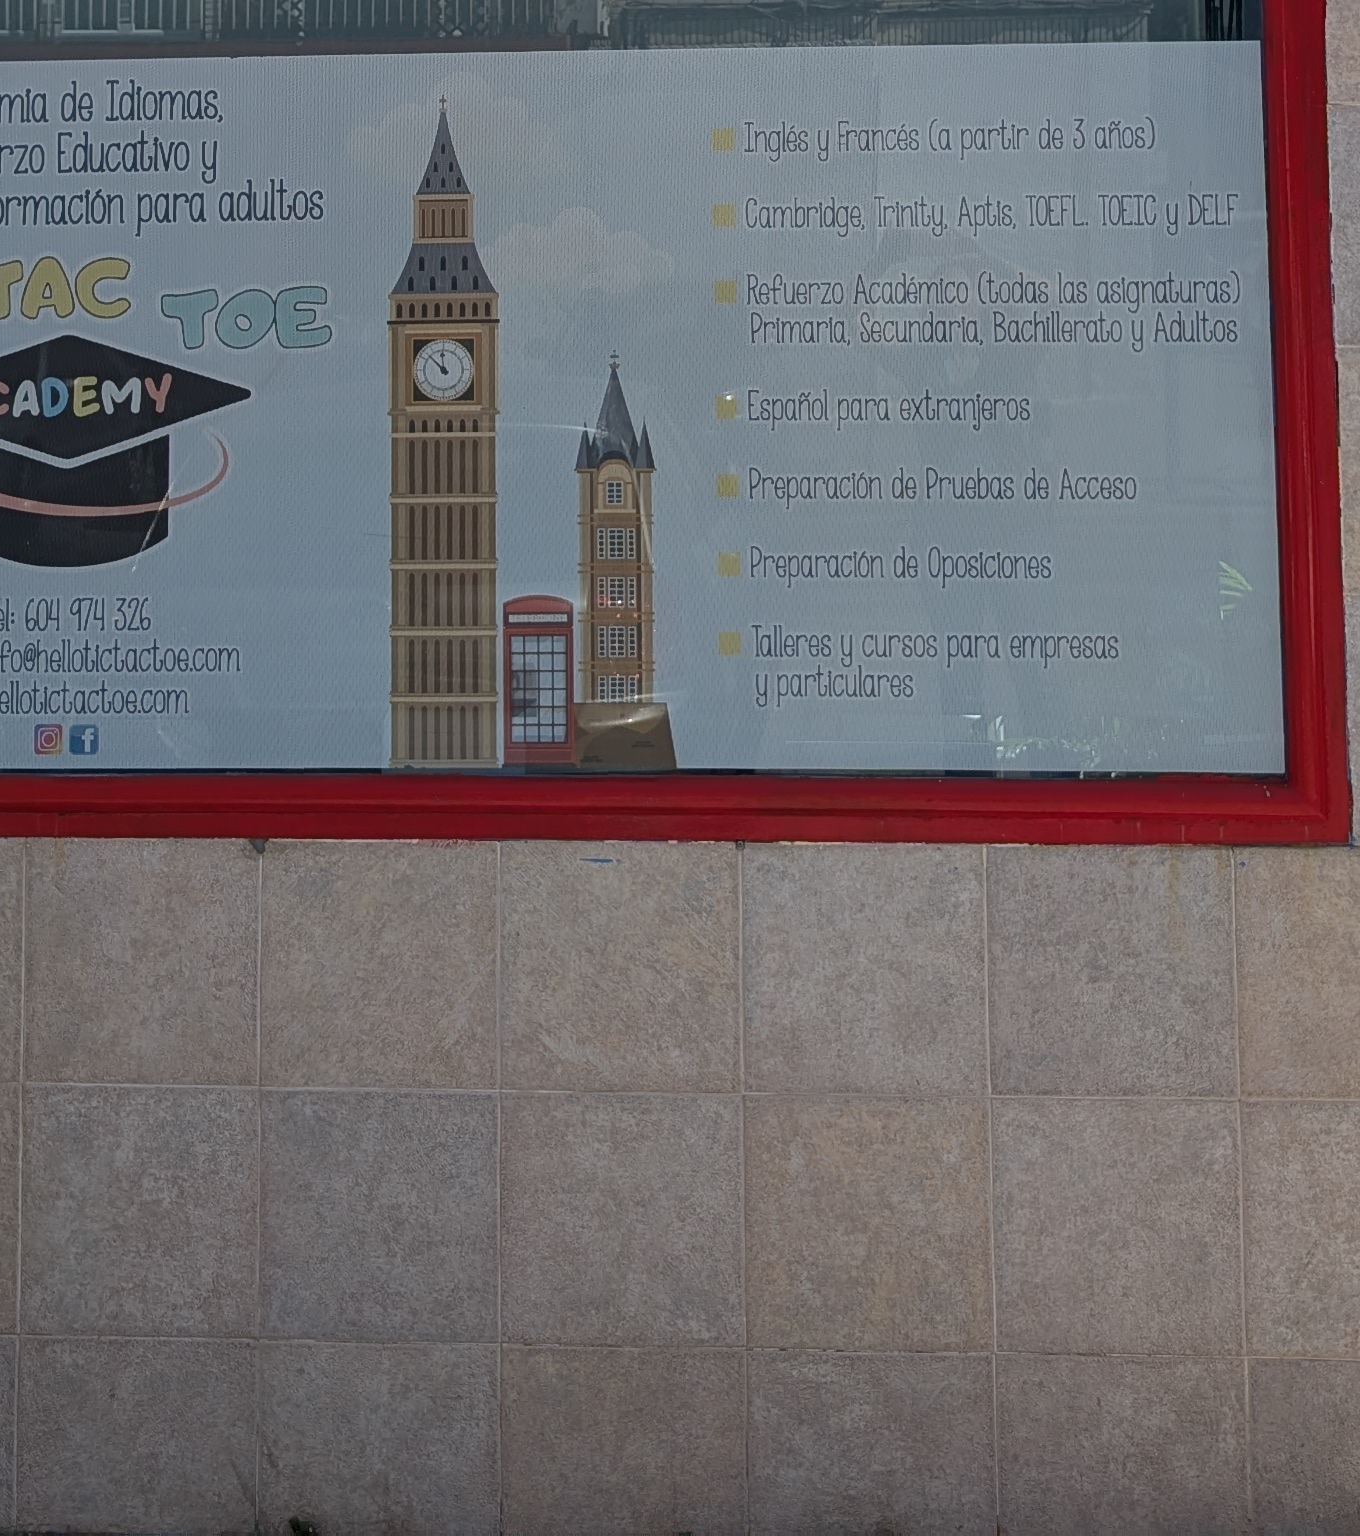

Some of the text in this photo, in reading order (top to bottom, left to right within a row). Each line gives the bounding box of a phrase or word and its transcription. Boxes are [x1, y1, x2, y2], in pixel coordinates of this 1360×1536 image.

[61, 81, 93, 122] de
[105, 79, 224, 123] Idiomas,
[58, 130, 190, 174] Educativo
[201, 139, 218, 184] y
[744, 117, 1156, 162] Inglés y Francés (a partir de 3 años)
[136, 190, 206, 237] para
[218, 179, 324, 222] adultos
[745, 197, 865, 236] Cambridge,
[874, 195, 948, 236] Trinity,
[957, 196, 1017, 236] Aptis,
[1098, 194, 1157, 227] TOEIC
[1166, 200, 1179, 236] y
[1187, 193, 1239, 227] DELF
[747, 270, 1241, 313] Refuerzo Académico (todas las asignaturas)
[161, 286, 332, 349] TOE
[750, 310, 1239, 352] Primaria, Secundaria, Bachillerato y Adultos
[747, 389, 1031, 431] Español para extranjeros
[748, 467, 1137, 509] Preparación de Pruebas de Acceso
[749, 545, 1052, 589] Preparación de Oposiciones
[24, 597, 60, 632] 604
[70, 597, 105, 632] 974
[114, 597, 151, 632] 326
[751, 624, 1119, 668] Talleres y cursos para empresas
[755, 666, 914, 707] y particulares
